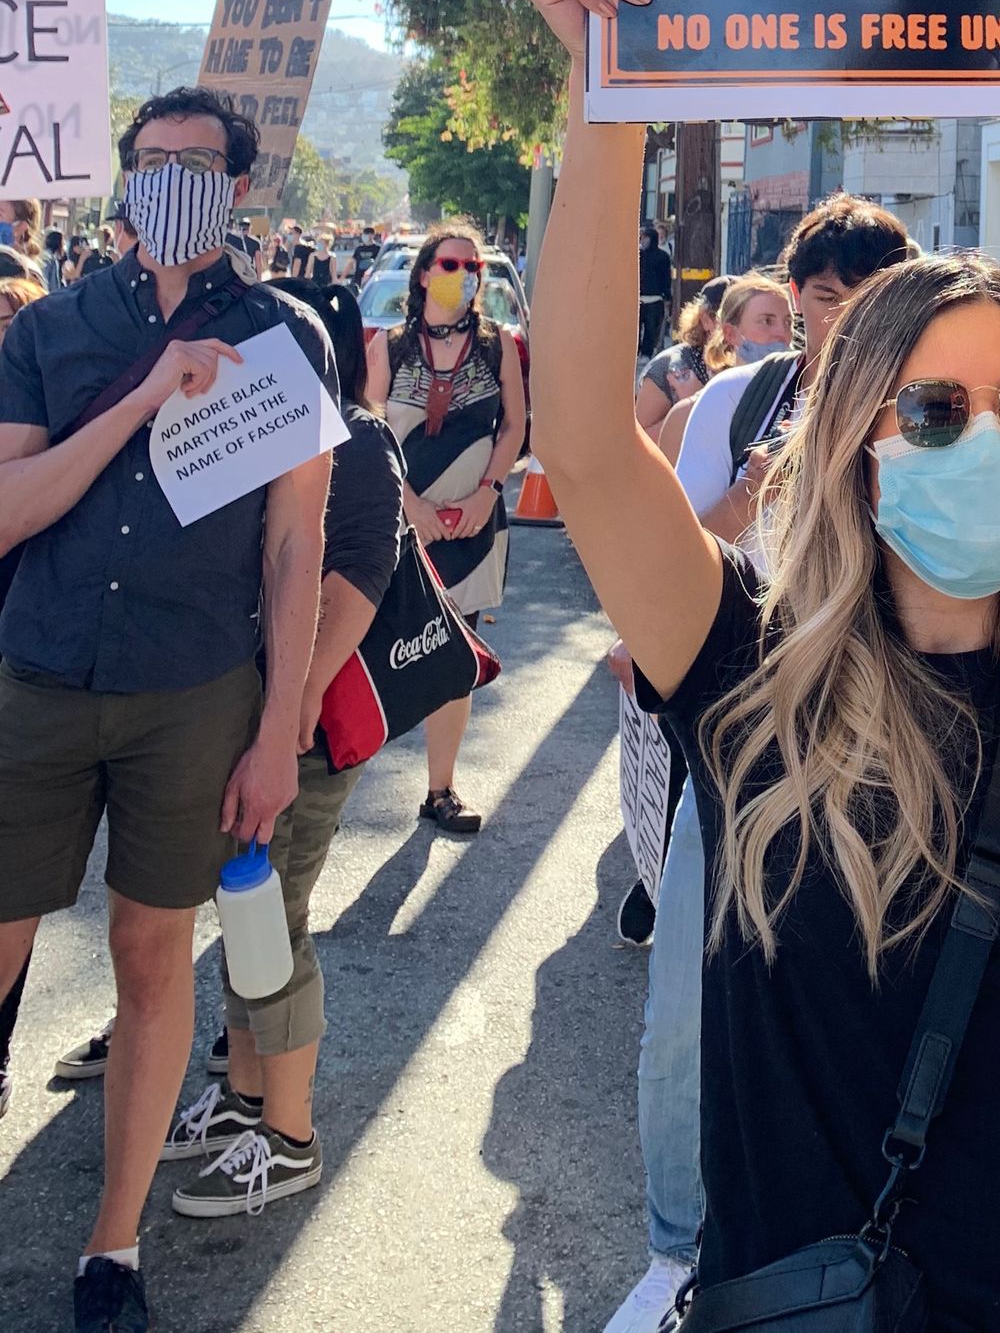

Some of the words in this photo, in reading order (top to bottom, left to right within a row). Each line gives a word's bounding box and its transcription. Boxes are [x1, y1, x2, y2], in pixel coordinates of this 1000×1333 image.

[204, 37, 254, 75] HAVE
[258, 36, 284, 75] TO
[285, 35, 317, 78] BE
[658, 14, 711, 51] NO
[725, 14, 799, 51] ONE
[814, 14, 848, 50] IS
[861, 13, 948, 51] FREE
[160, 422, 182, 443] NO
[183, 397, 230, 429] MORE
[231, 373, 278, 404] BLACK
[166, 417, 239, 461] MARTYRS
[240, 407, 258, 424] IN
[258, 391, 288, 414] THE
[175, 448, 224, 481] NAME
[225, 436, 246, 455] OF
[247, 404, 310, 443] FASCISM
[389, 615, 450, 670] Coca-Cola
